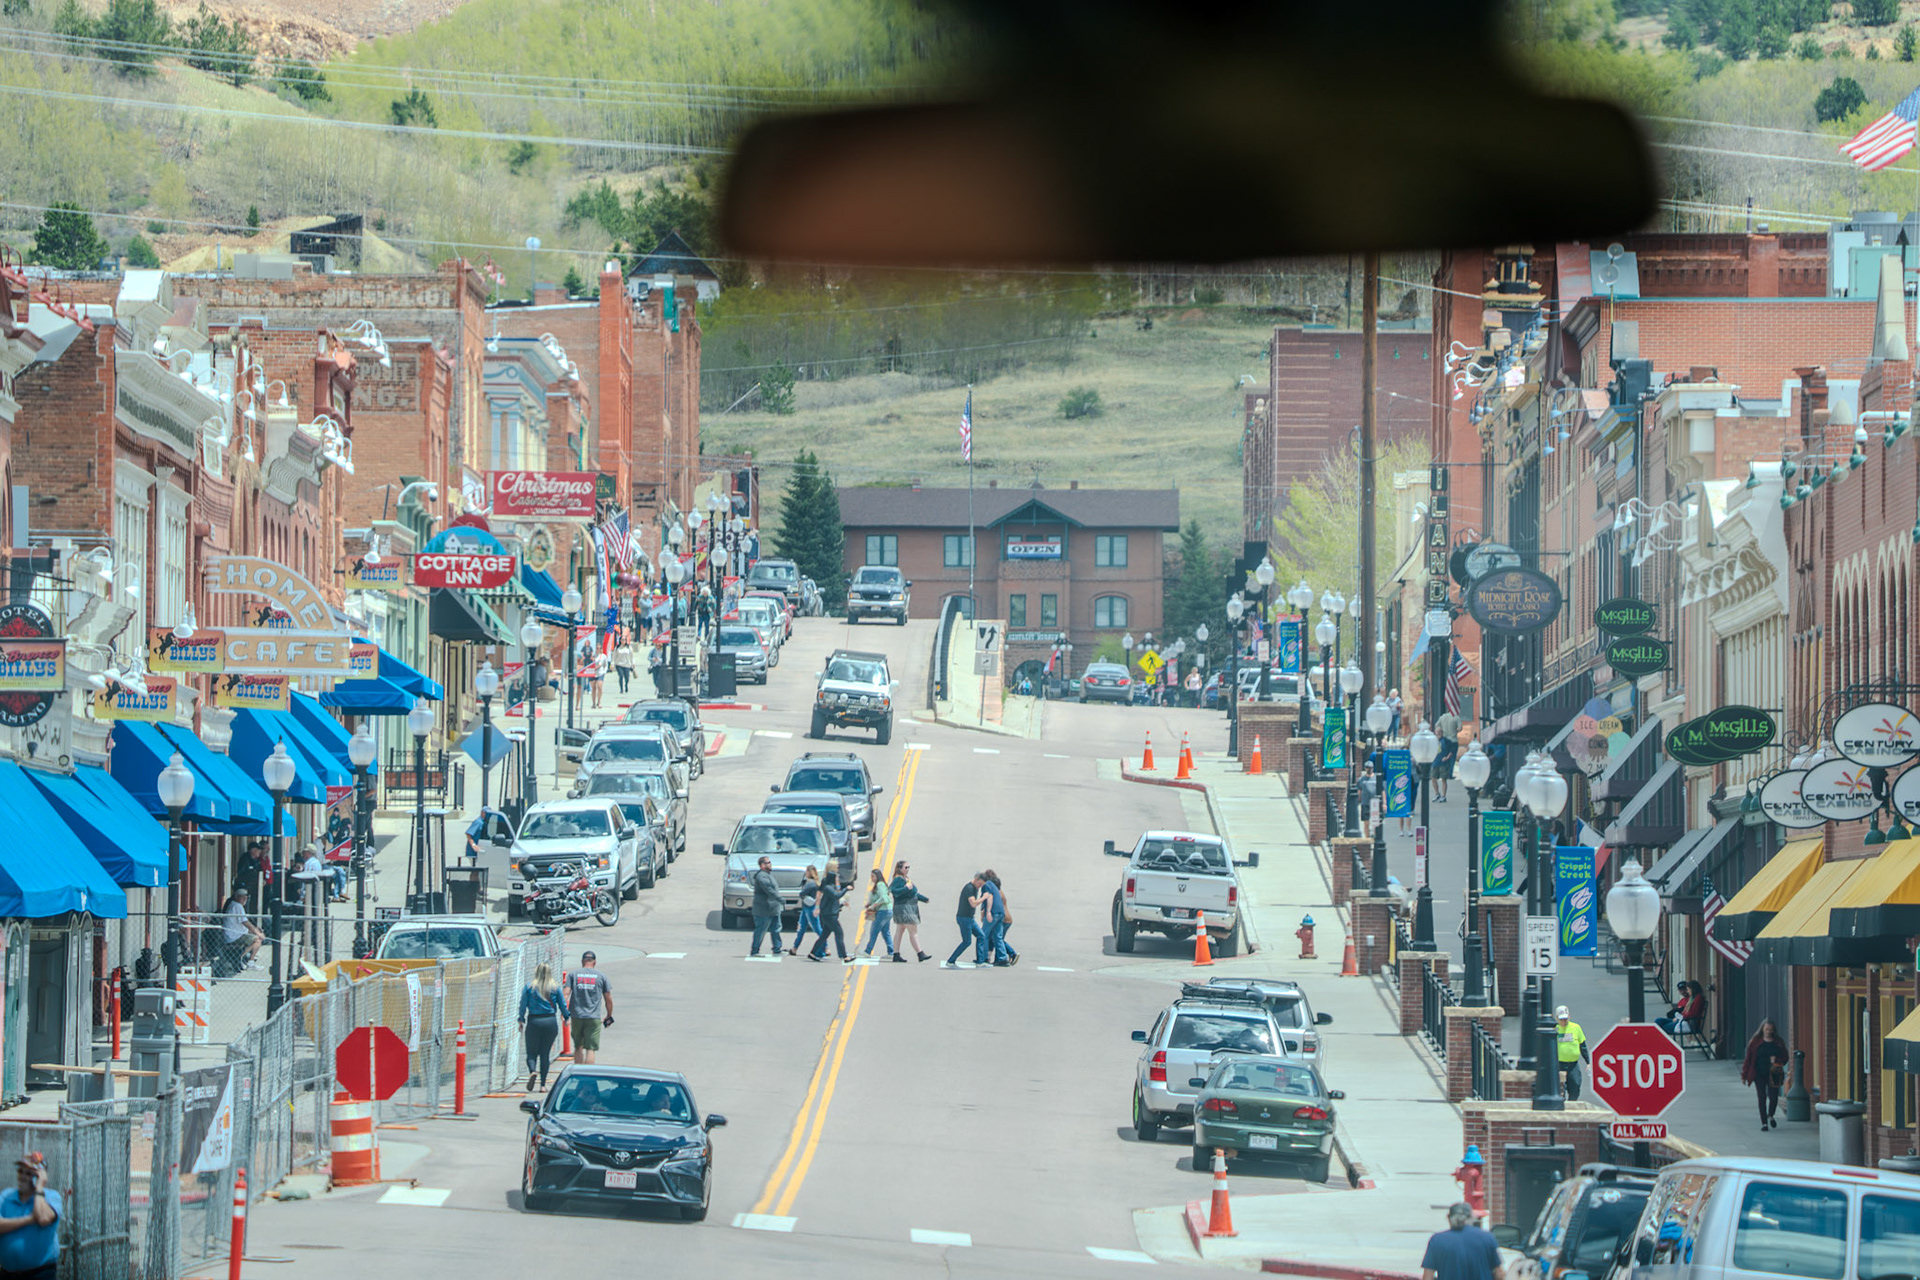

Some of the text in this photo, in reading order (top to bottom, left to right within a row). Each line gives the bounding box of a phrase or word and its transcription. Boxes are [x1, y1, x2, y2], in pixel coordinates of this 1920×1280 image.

[497, 472, 593, 494] Christmas
[1012, 545, 1057, 554] OPEN
[418, 556, 511, 572] COTTAGE
[445, 571, 482, 584] INN
[226, 564, 323, 628] HOME
[1479, 591, 1550, 603] MIDNIGHT ROSE
[1, 606, 46, 629] OTEL
[170, 645, 216, 661] BILLYS
[227, 641, 335, 663] CAFE
[236, 684, 280, 699] BILLYS
[117, 693, 167, 709] BILLYS
[0, 702, 46, 723] ASINO
[1580, 721, 1619, 729] ICE CREAM
[1844, 740, 1914, 748] CENTURY
[1806, 793, 1873, 801] CENTURY
[1816, 800, 1872, 808] CASINO
[1559, 863, 1591, 871] Cripple
[1528, 923, 1554, 932] SPEED
[1531, 936, 1551, 944] LIMIT
[1532, 949, 1551, 968] 15
[1598, 1054, 1678, 1089] STOP
[1616, 1126, 1663, 1137] ALL WAY
